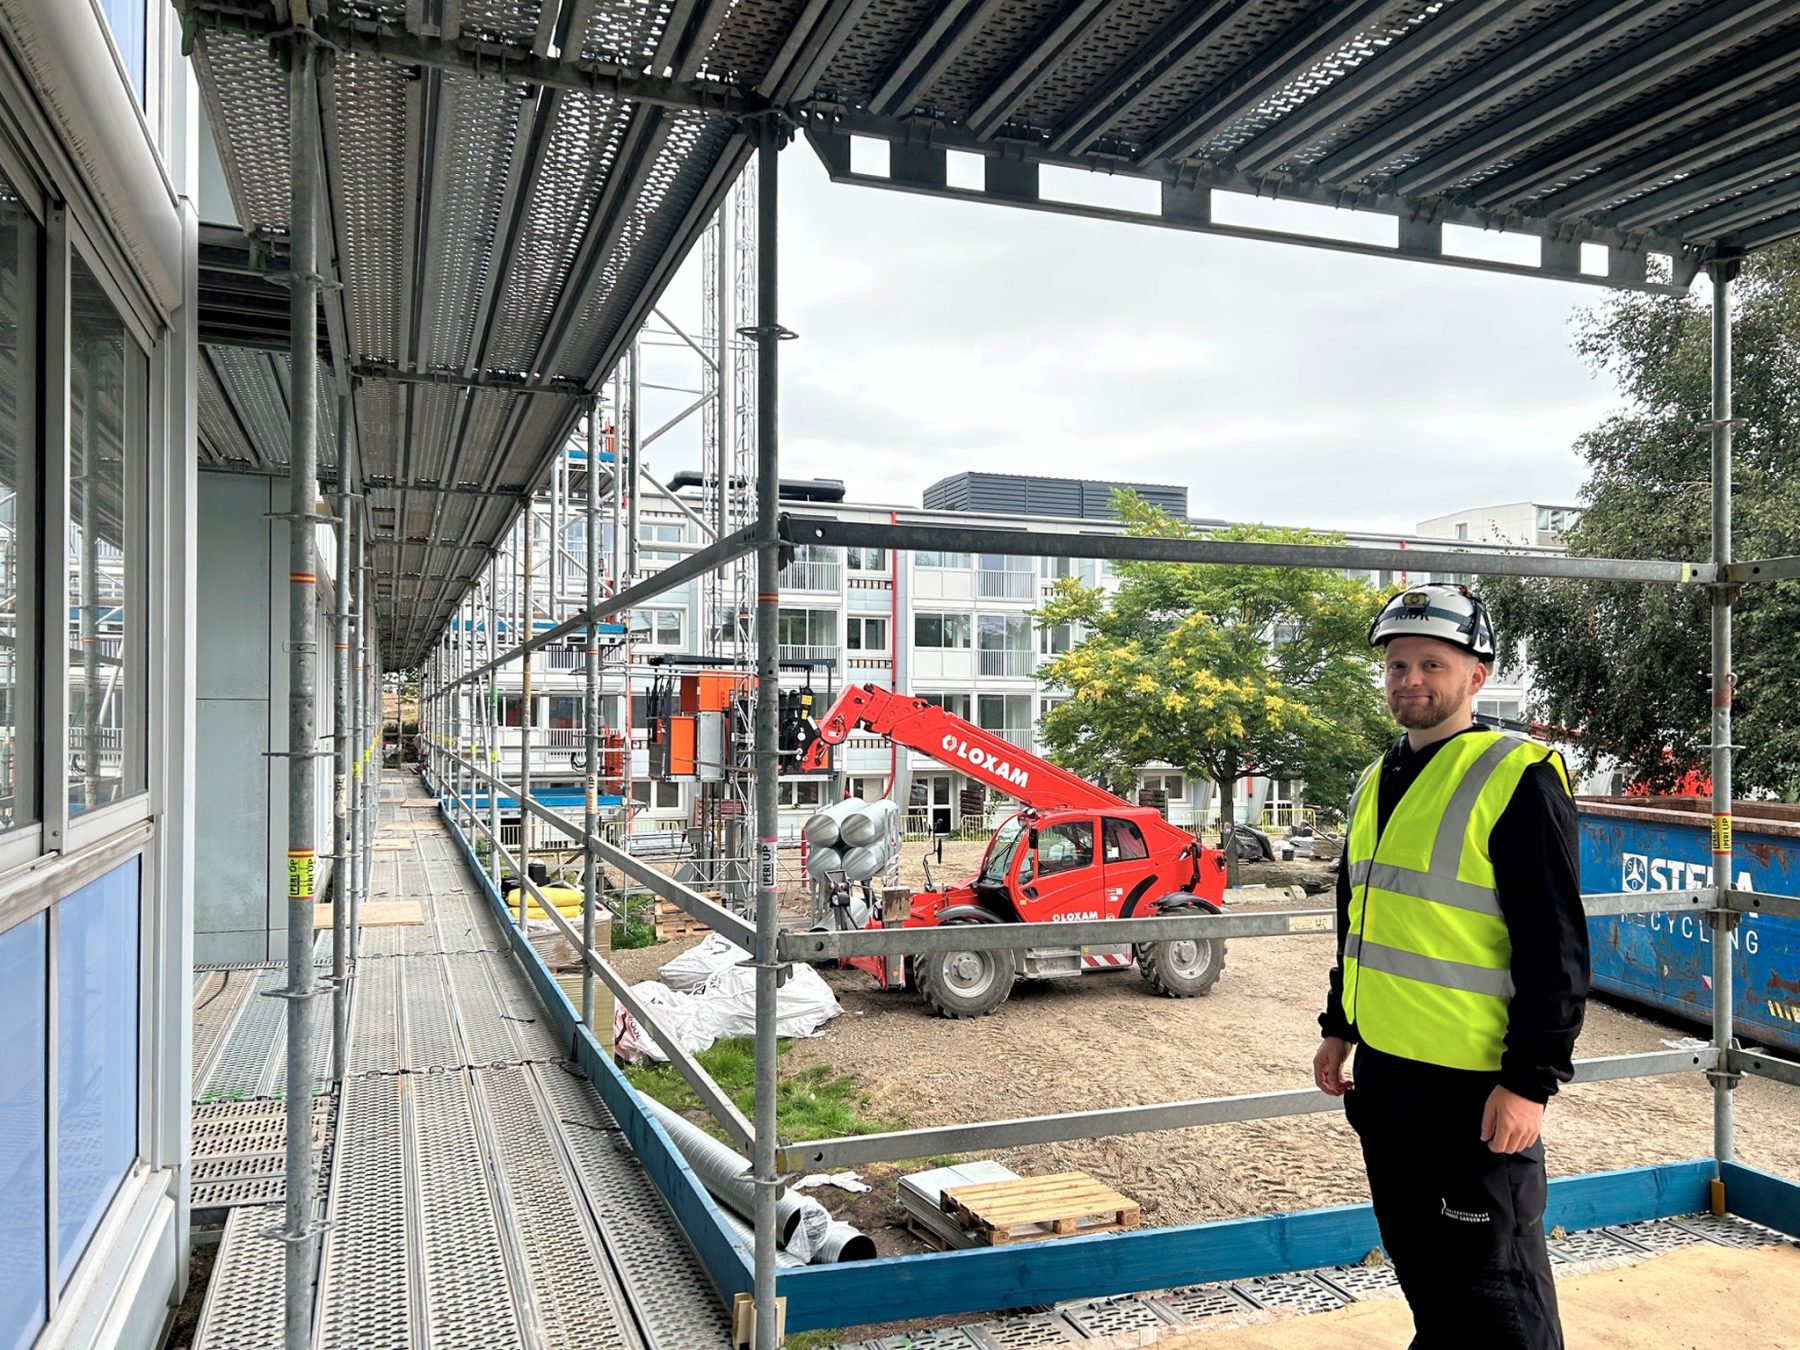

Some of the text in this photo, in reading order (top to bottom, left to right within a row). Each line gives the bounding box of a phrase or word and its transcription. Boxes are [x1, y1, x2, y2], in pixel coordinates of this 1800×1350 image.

[957, 741, 1029, 789] LOXAM
[289, 859, 298, 872] UP
[762, 845, 771, 882] PERI UP
[1060, 911, 1098, 922] LOXAM
